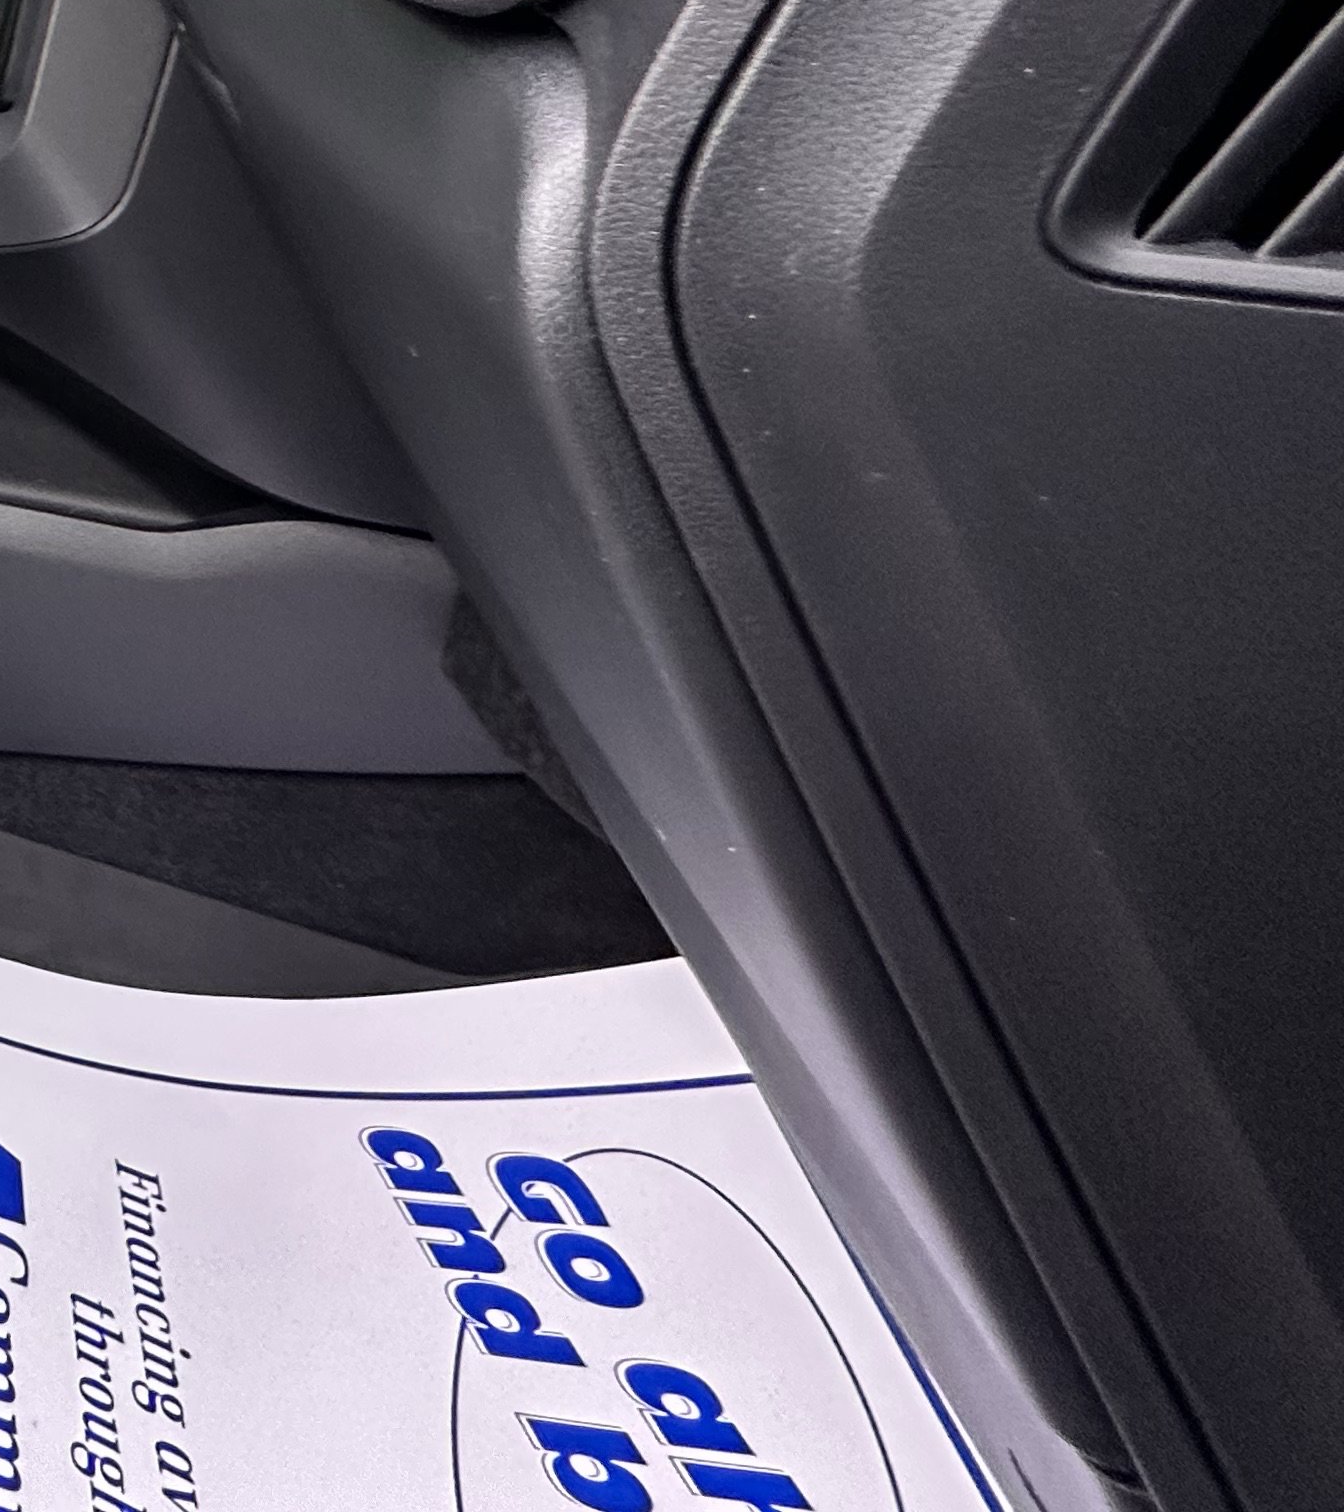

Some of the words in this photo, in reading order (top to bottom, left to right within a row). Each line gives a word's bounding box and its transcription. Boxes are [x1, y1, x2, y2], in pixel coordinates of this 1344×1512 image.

[115, 1159, 193, 1429] Financing
[358, 1125, 587, 1367] and
[486, 1151, 646, 1309] Go
